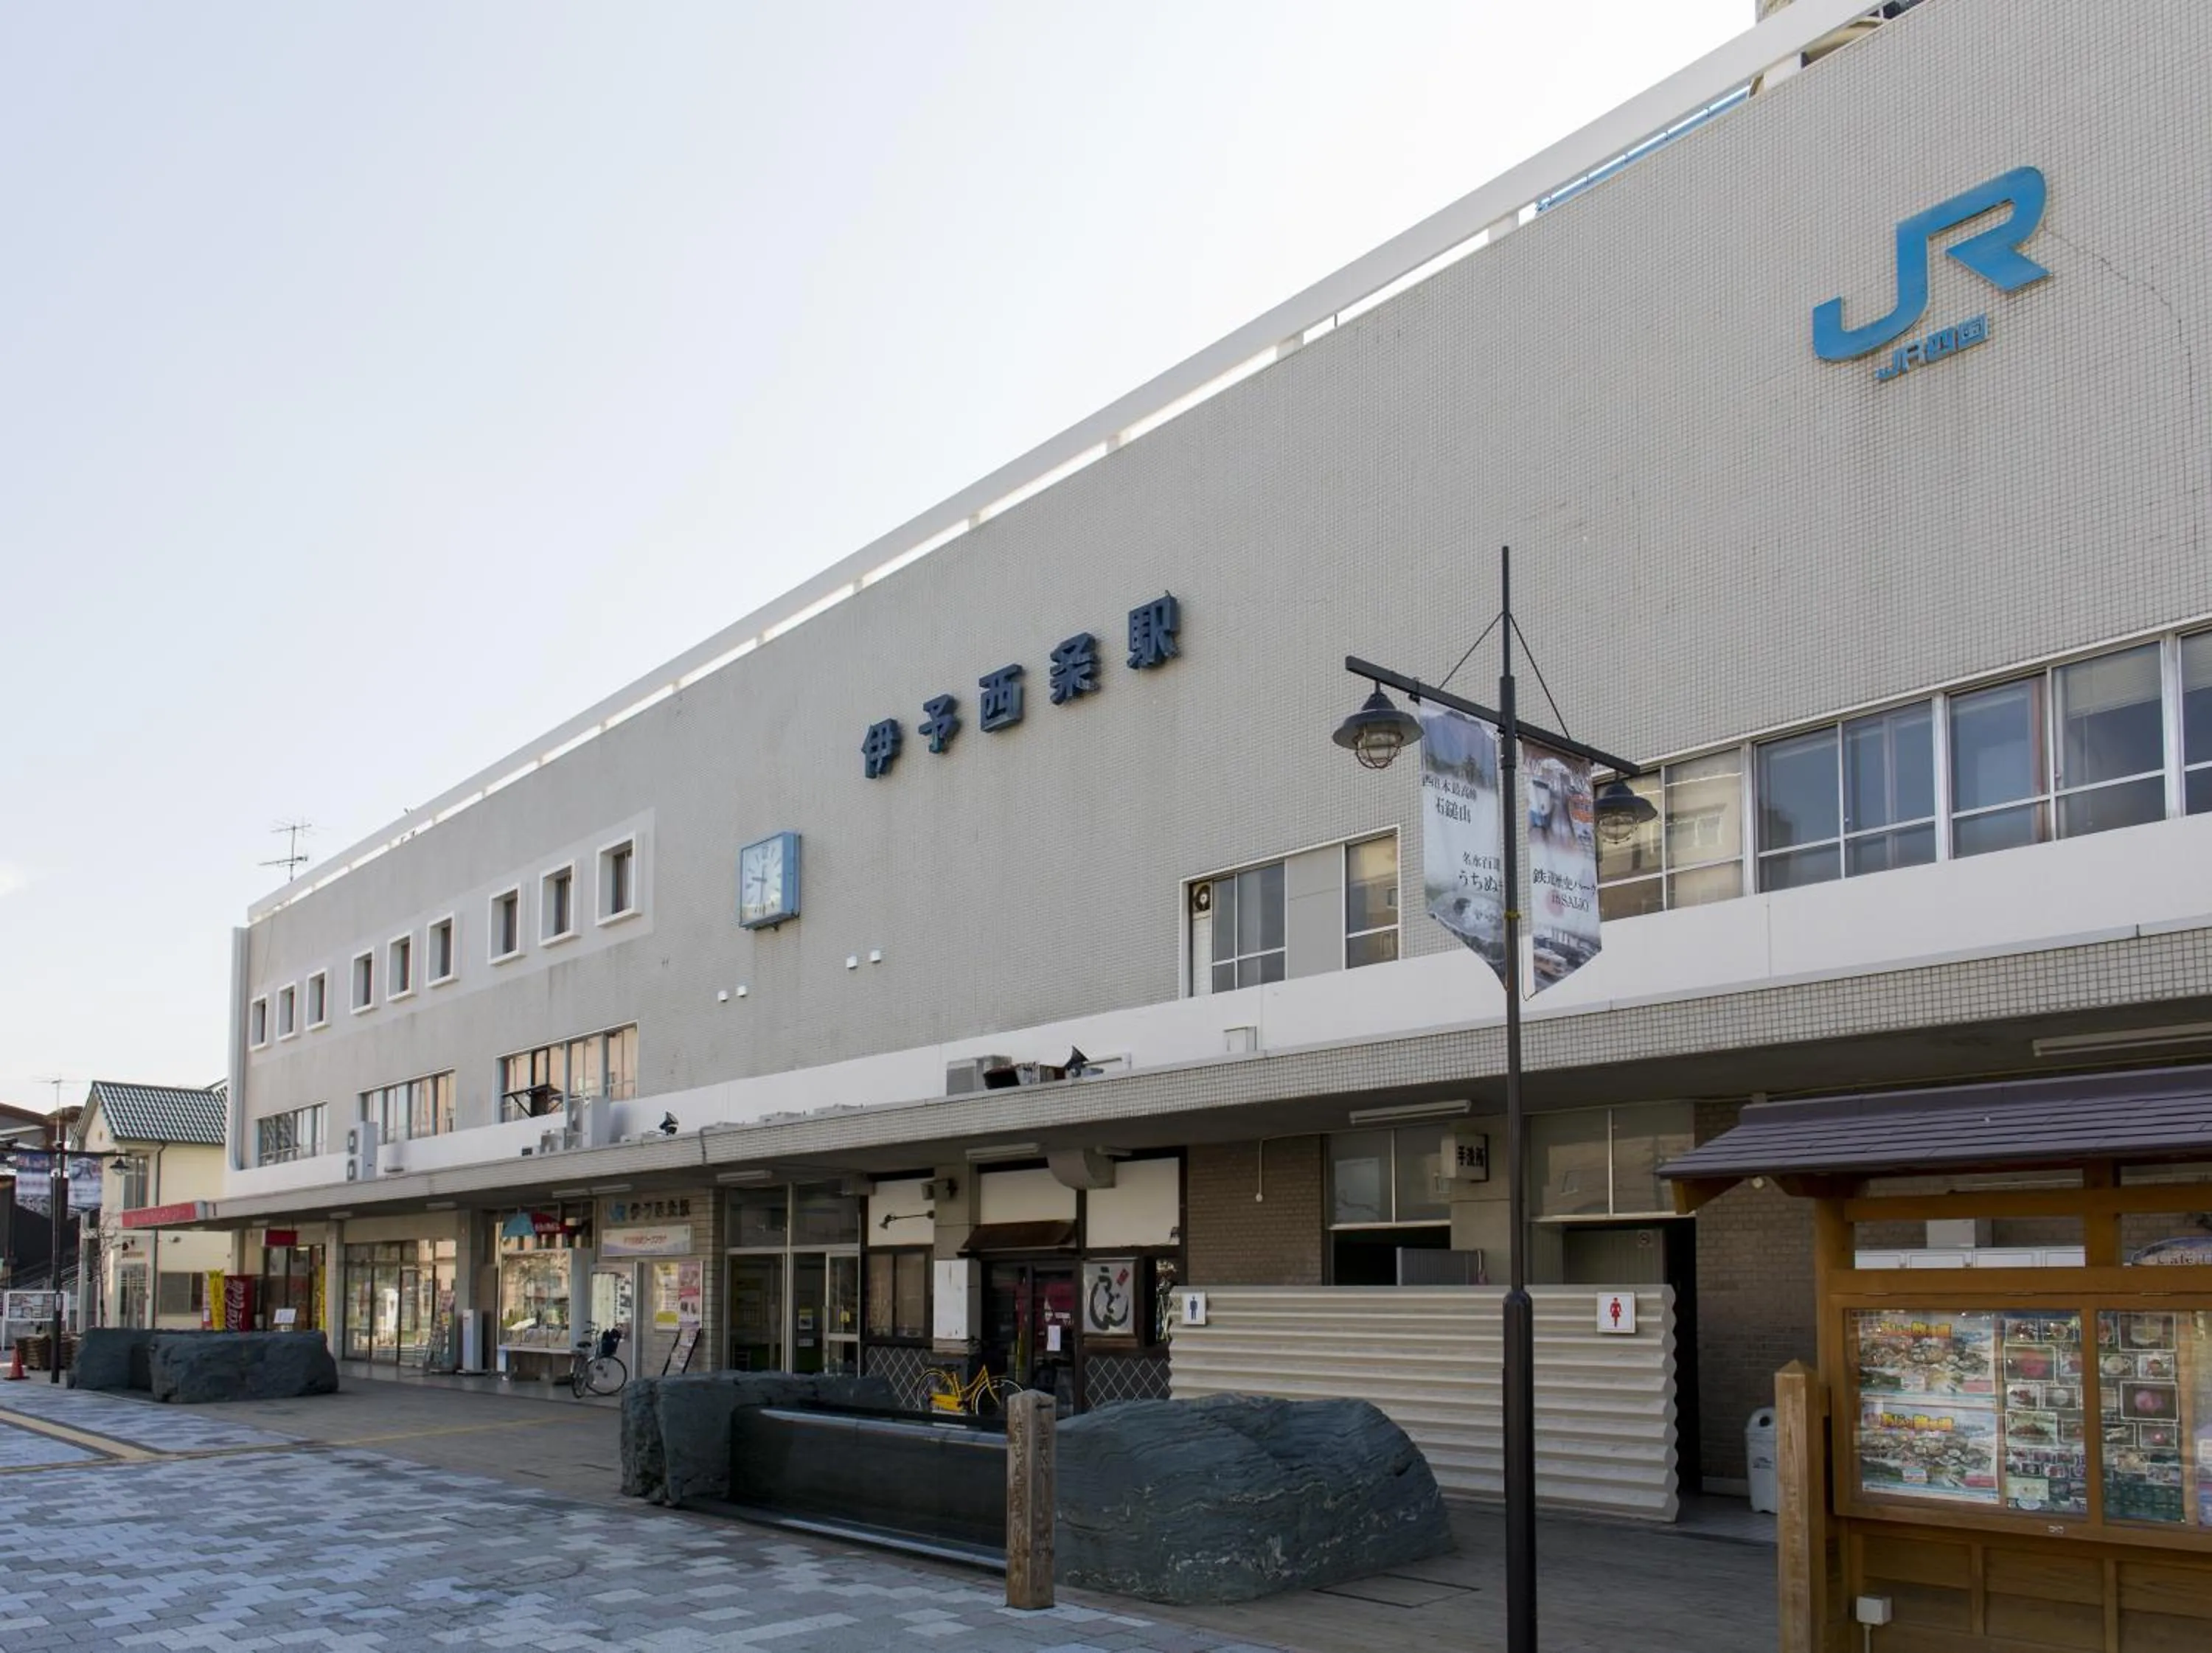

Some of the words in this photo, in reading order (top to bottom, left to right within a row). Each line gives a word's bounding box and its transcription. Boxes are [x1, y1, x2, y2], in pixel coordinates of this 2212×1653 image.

[1812, 165, 2053, 361] JR
[1876, 313, 1989, 381] JR四国
[861, 592, 1181, 779] 伊予西条駅
